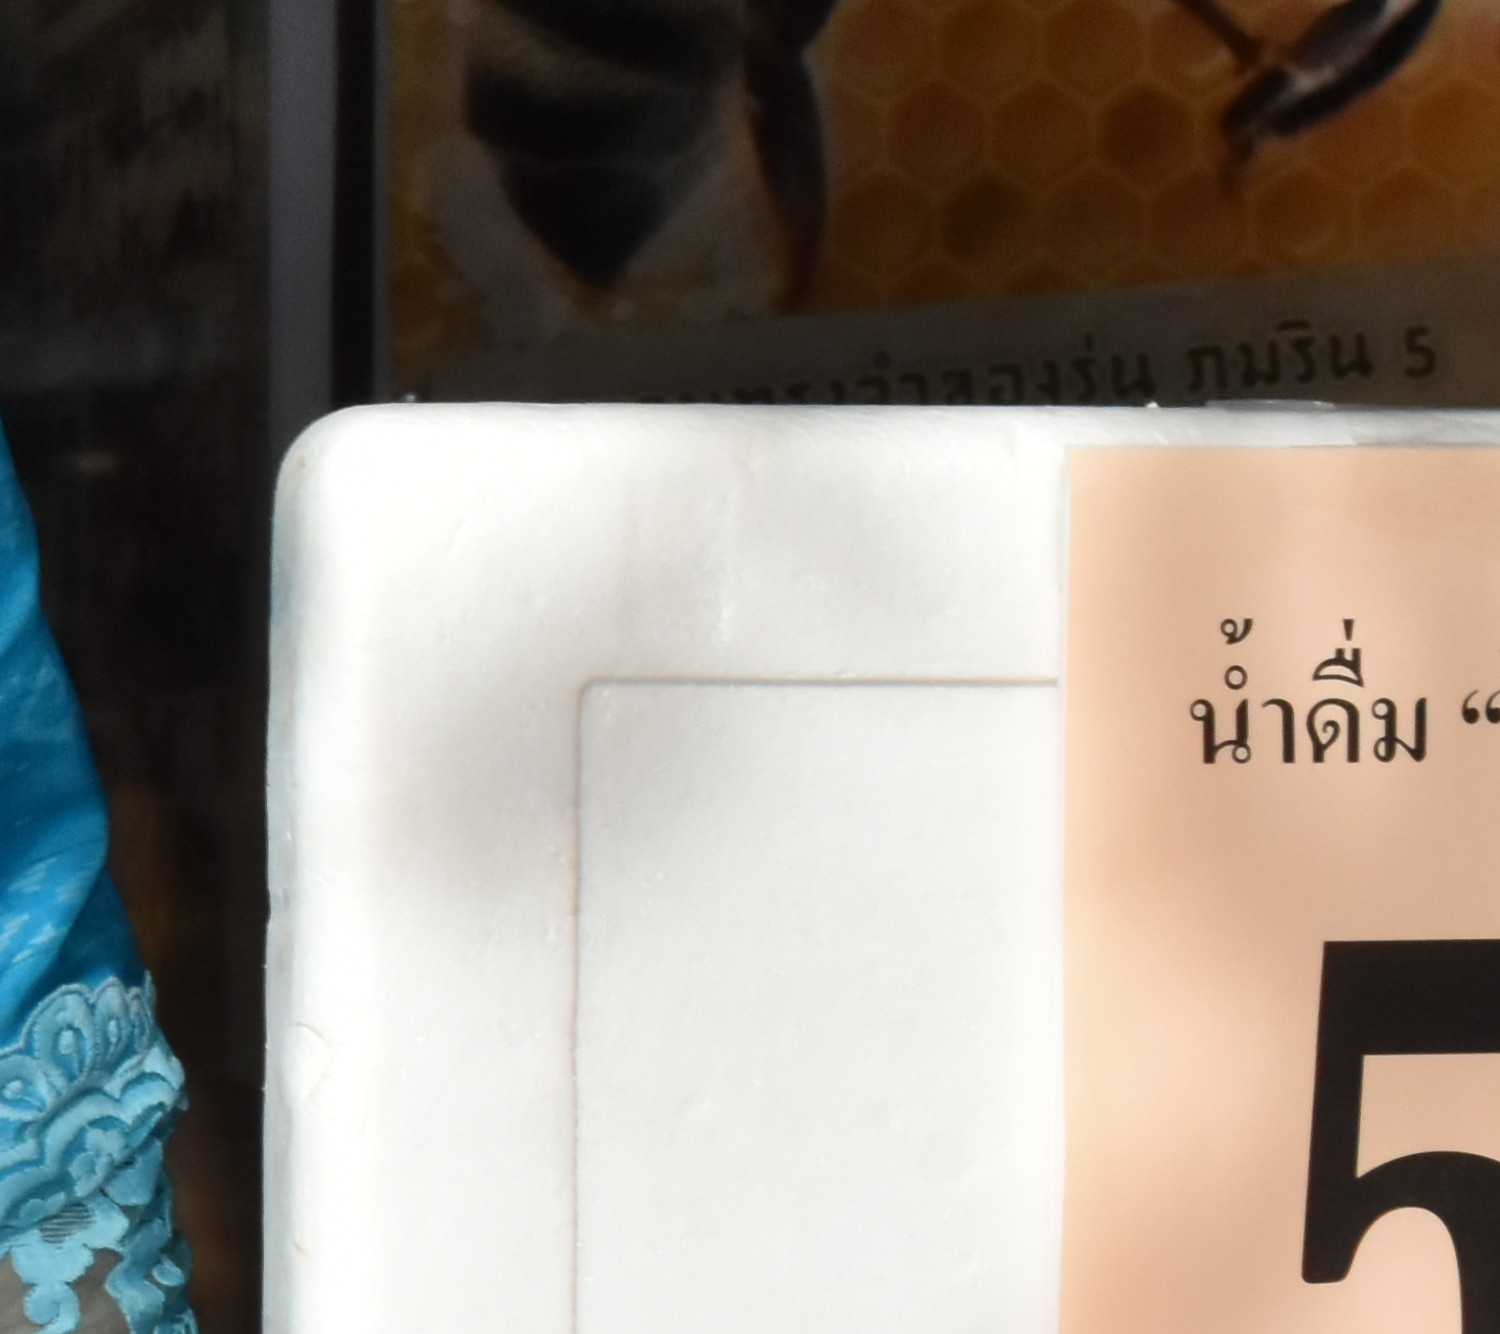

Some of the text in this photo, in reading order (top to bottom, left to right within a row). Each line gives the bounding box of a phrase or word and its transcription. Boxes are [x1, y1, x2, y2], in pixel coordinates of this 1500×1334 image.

[1403, 325, 1437, 379] 5
[1189, 618, 1428, 765] น้ำดื่ม
